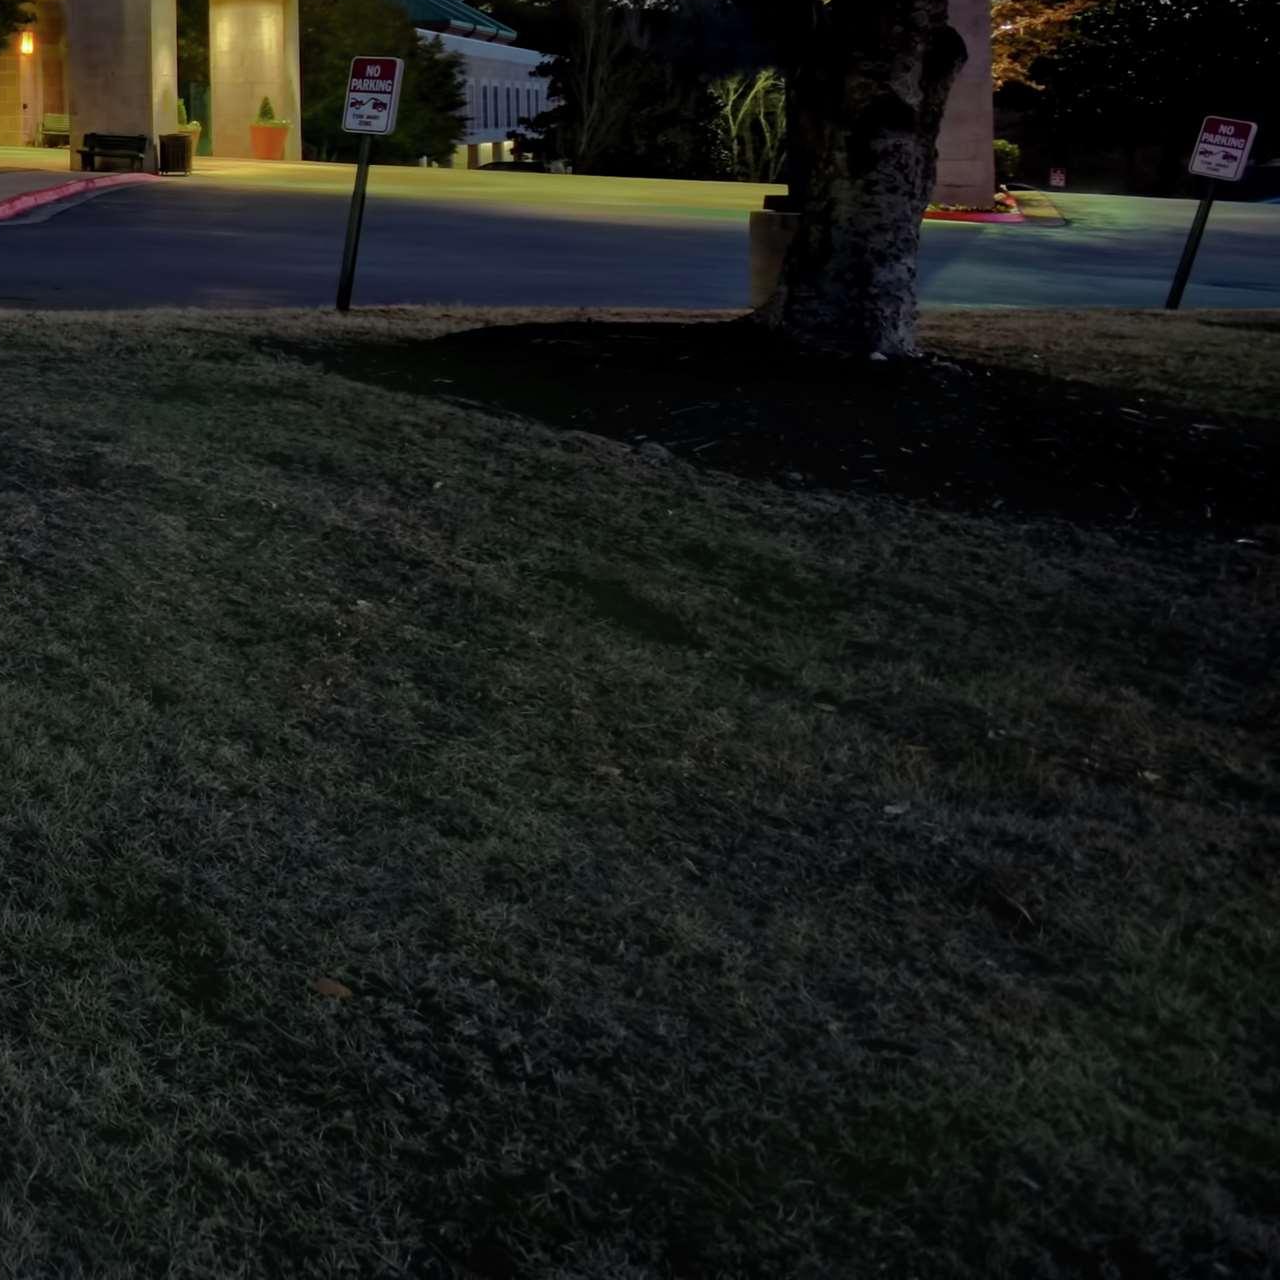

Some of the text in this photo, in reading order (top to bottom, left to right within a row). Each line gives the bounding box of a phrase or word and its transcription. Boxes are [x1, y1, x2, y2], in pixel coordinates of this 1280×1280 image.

[365, 64, 381, 78] NO
[350, 78, 393, 92] PARKING
[1218, 123, 1235, 135] NO
[1200, 132, 1246, 149] PARKING
